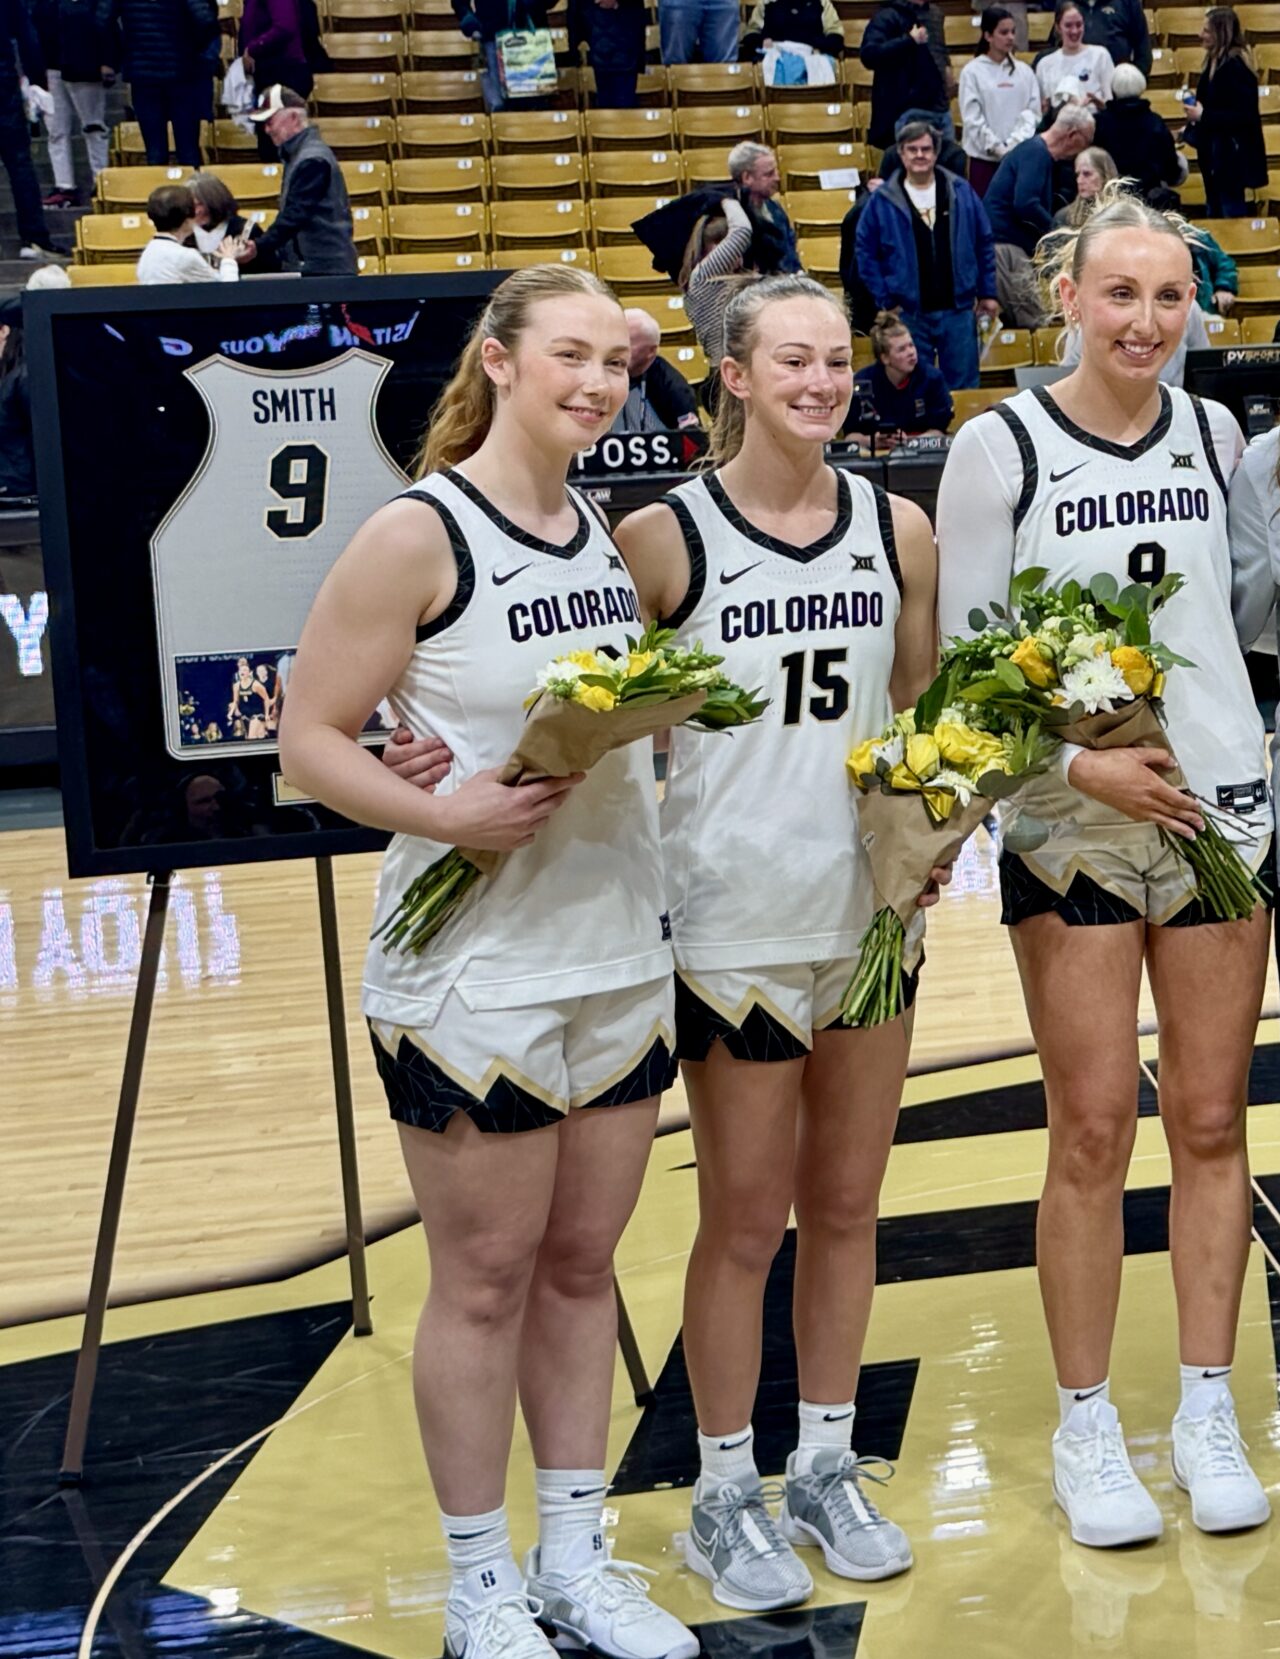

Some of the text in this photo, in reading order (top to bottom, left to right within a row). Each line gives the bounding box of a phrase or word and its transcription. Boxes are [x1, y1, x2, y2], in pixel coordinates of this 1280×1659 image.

[252, 388, 337, 424] SMITH
[577, 435, 679, 470] POSS.
[264, 440, 332, 541] 9
[1055, 487, 1209, 537] COLORADO
[507, 586, 642, 643] COLORADO
[721, 591, 883, 644] COLORADO
[780, 647, 849, 726] 15
